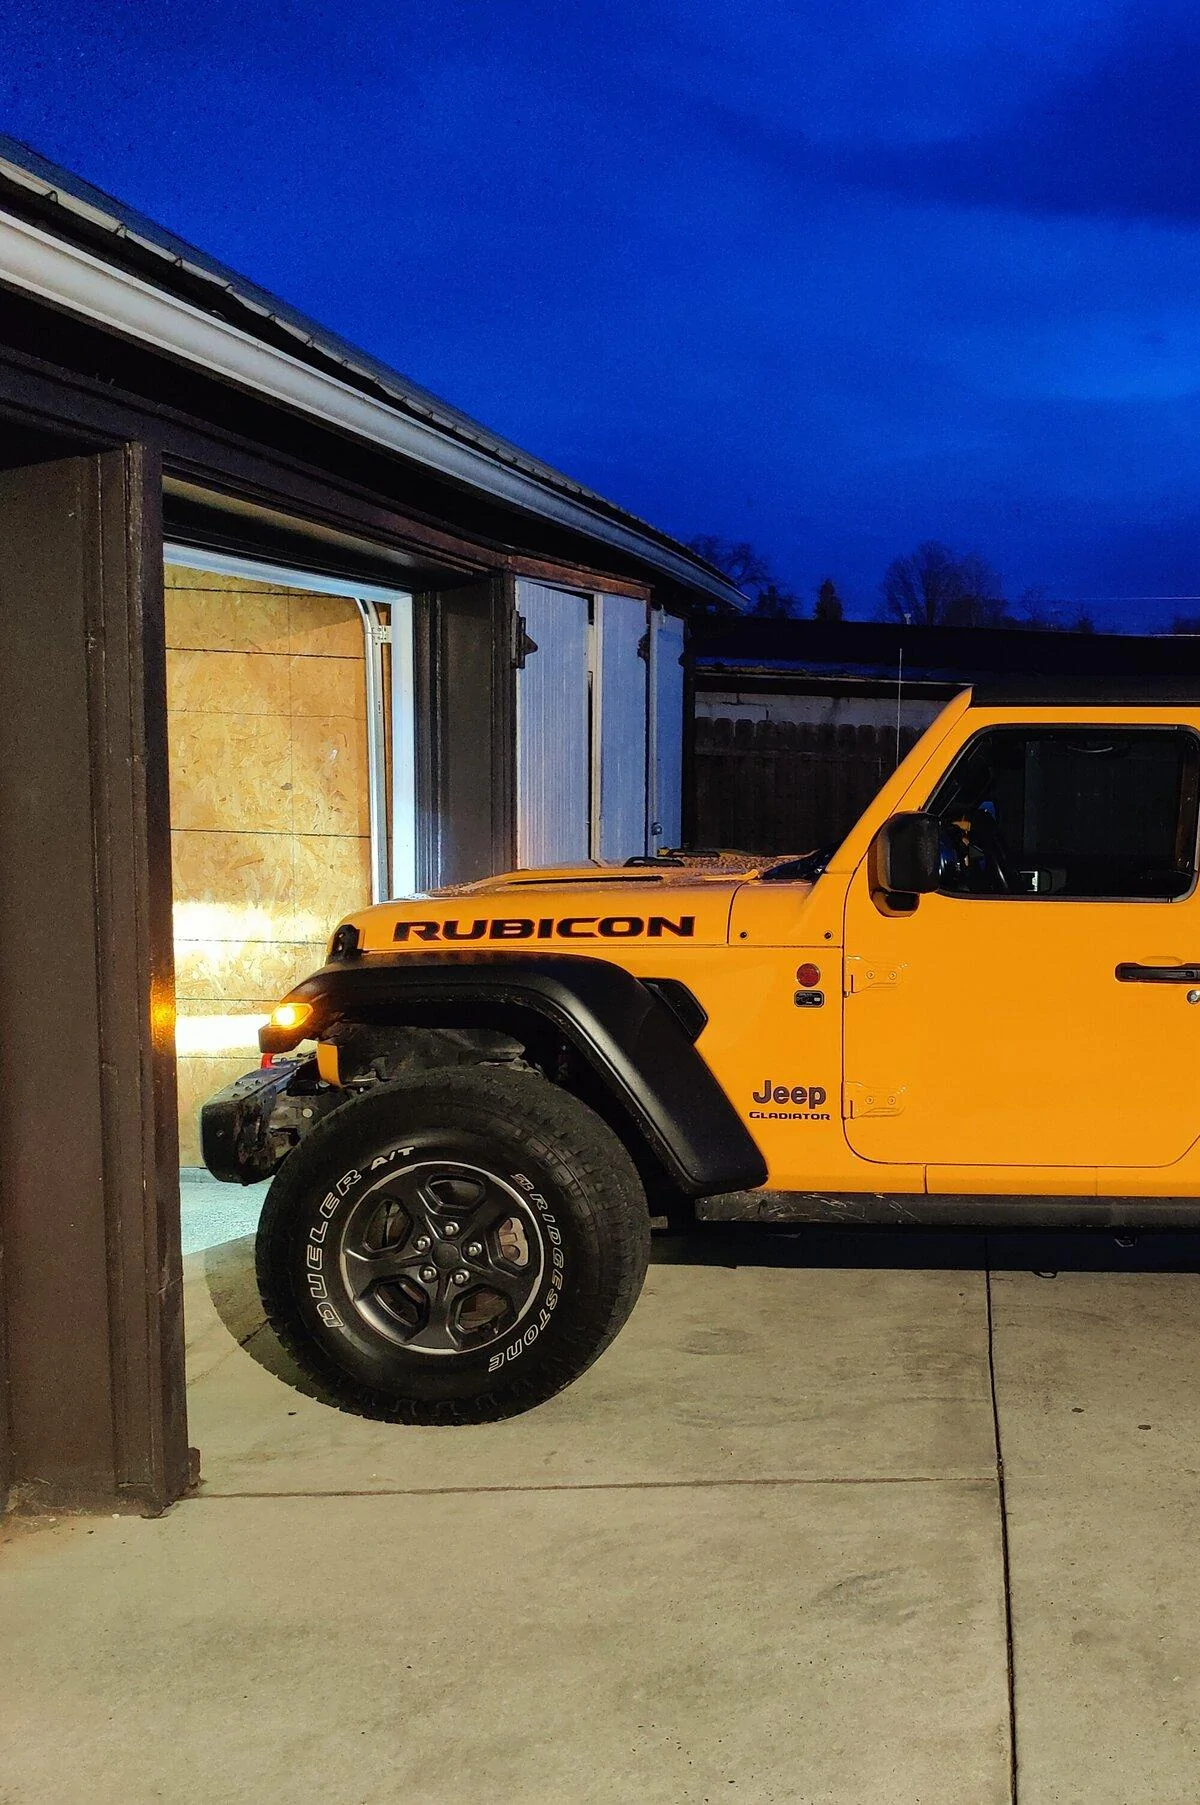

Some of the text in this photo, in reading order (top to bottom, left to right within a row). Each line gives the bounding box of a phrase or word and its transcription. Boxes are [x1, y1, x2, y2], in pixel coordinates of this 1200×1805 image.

[392, 916, 696, 942] RUBICON
[752, 1080, 826, 1109] Jeep
[749, 1111, 831, 1120] GLADIATOR
[306, 1146, 415, 1328] DUELER A/T
[488, 1173, 564, 1373] BRIDGESTONE
